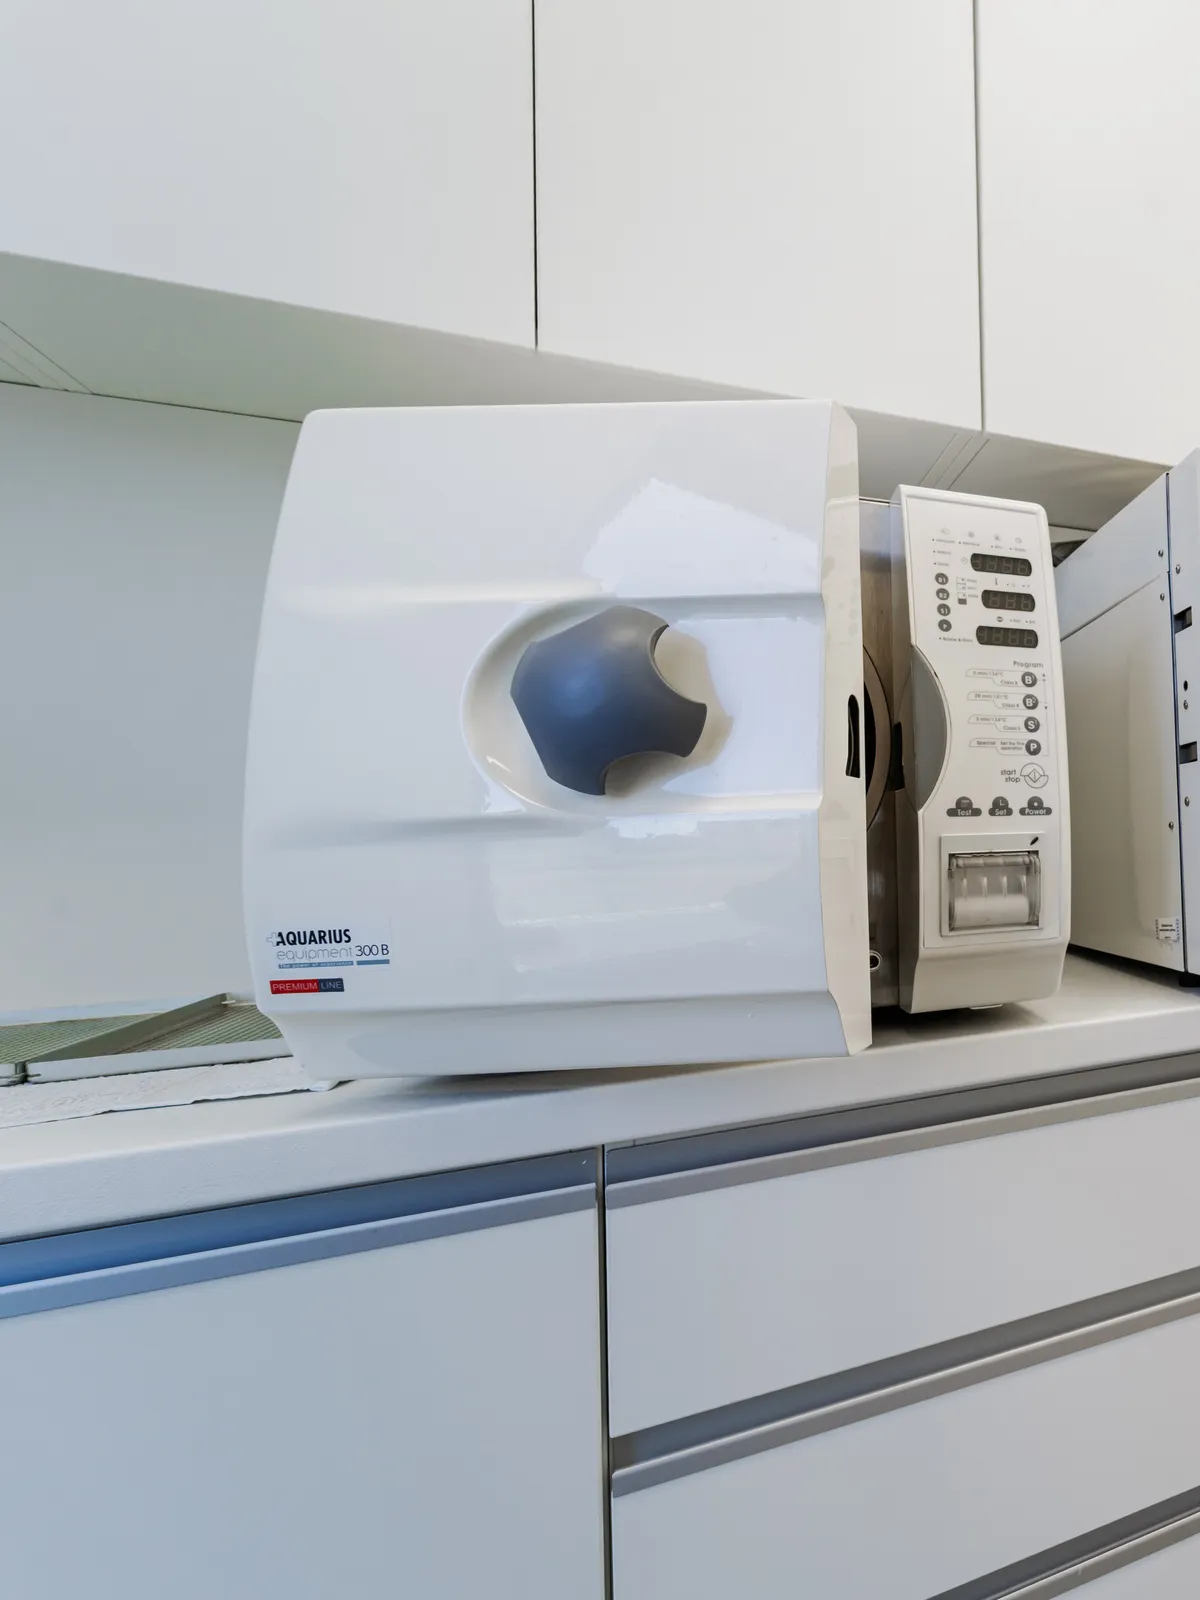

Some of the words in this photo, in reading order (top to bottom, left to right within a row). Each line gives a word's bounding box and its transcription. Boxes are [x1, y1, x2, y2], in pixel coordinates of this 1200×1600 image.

[1013, 660, 1044, 669] Program
[1005, 776, 1021, 784] stop
[276, 928, 352, 947] AQUARIUS
[276, 946, 353, 962] equipment
[355, 944, 379, 957] 300
[381, 944, 390, 956] B
[272, 982, 318, 991] PREMIUM
[320, 981, 342, 989] LINE
